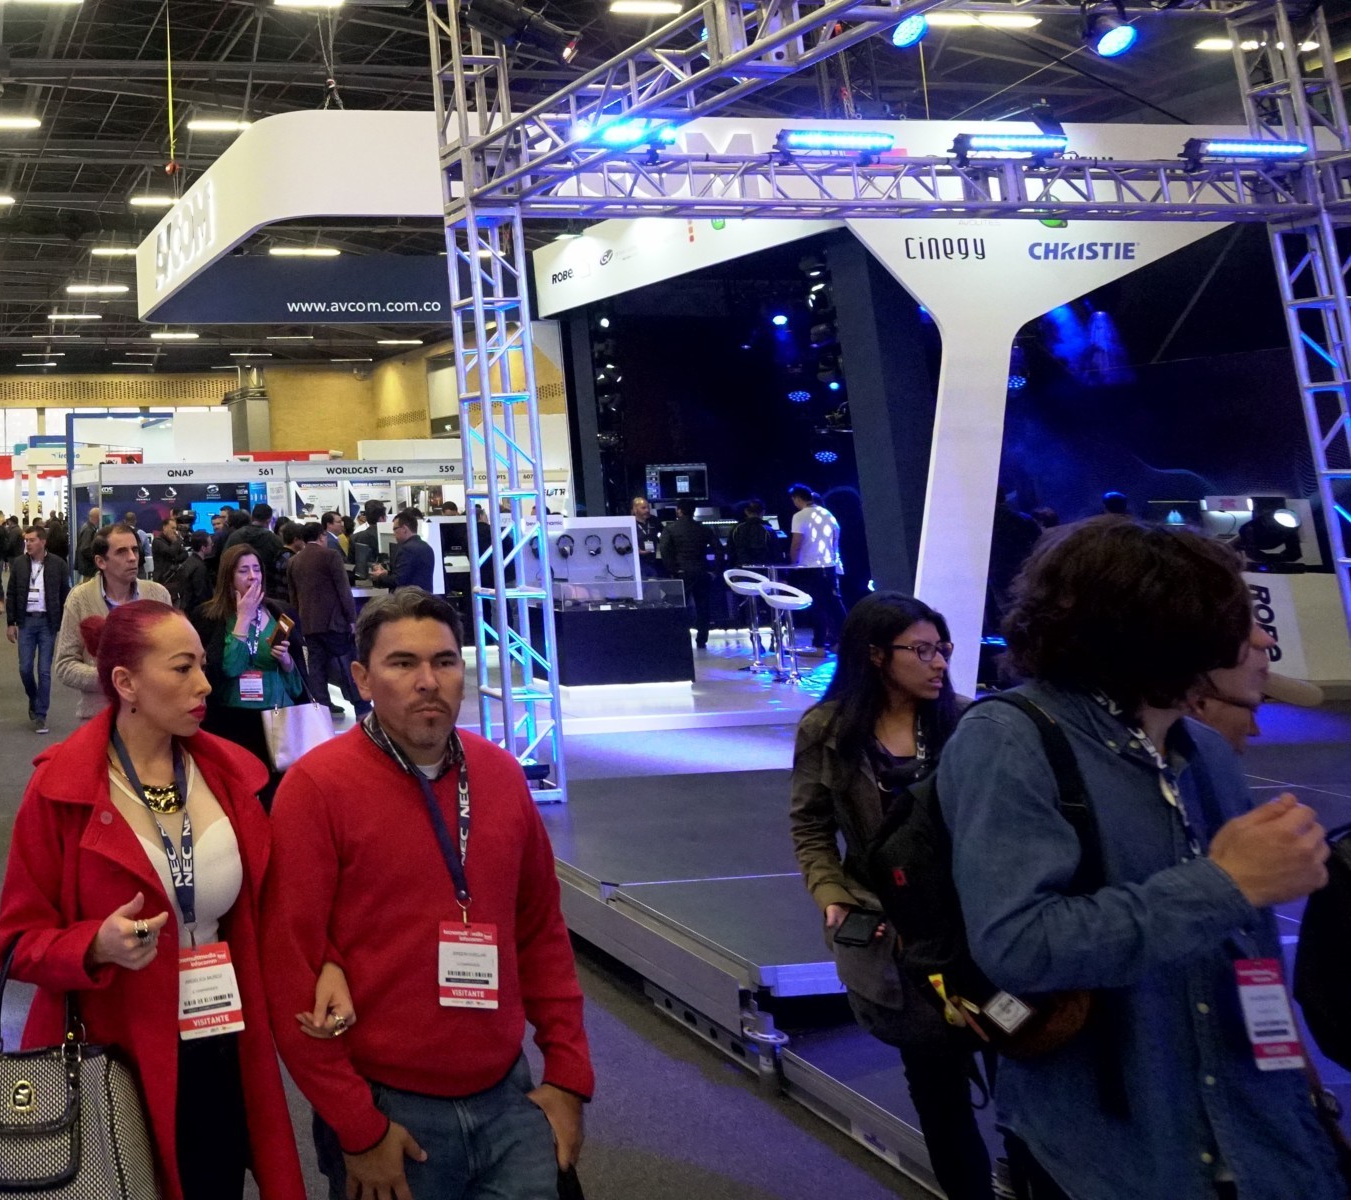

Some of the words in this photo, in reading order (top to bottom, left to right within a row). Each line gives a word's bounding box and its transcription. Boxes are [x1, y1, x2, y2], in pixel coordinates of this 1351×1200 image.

[1028, 242, 1136, 261] CHRISTIE
[286, 301, 442, 312] www.avcom.com.co
[167, 469, 194, 478] QNAP
[258, 468, 274, 476] 561
[326, 466, 378, 474] WORLDCAST
[386, 466, 404, 474] AEQ
[439, 465, 455, 473] 559
[458, 782, 470, 818] NEC
[166, 846, 185, 887] NEC
[181, 846, 194, 887] NEC
[451, 988, 485, 998] VISITANTE
[193, 1014, 230, 1027] VISITANTE
